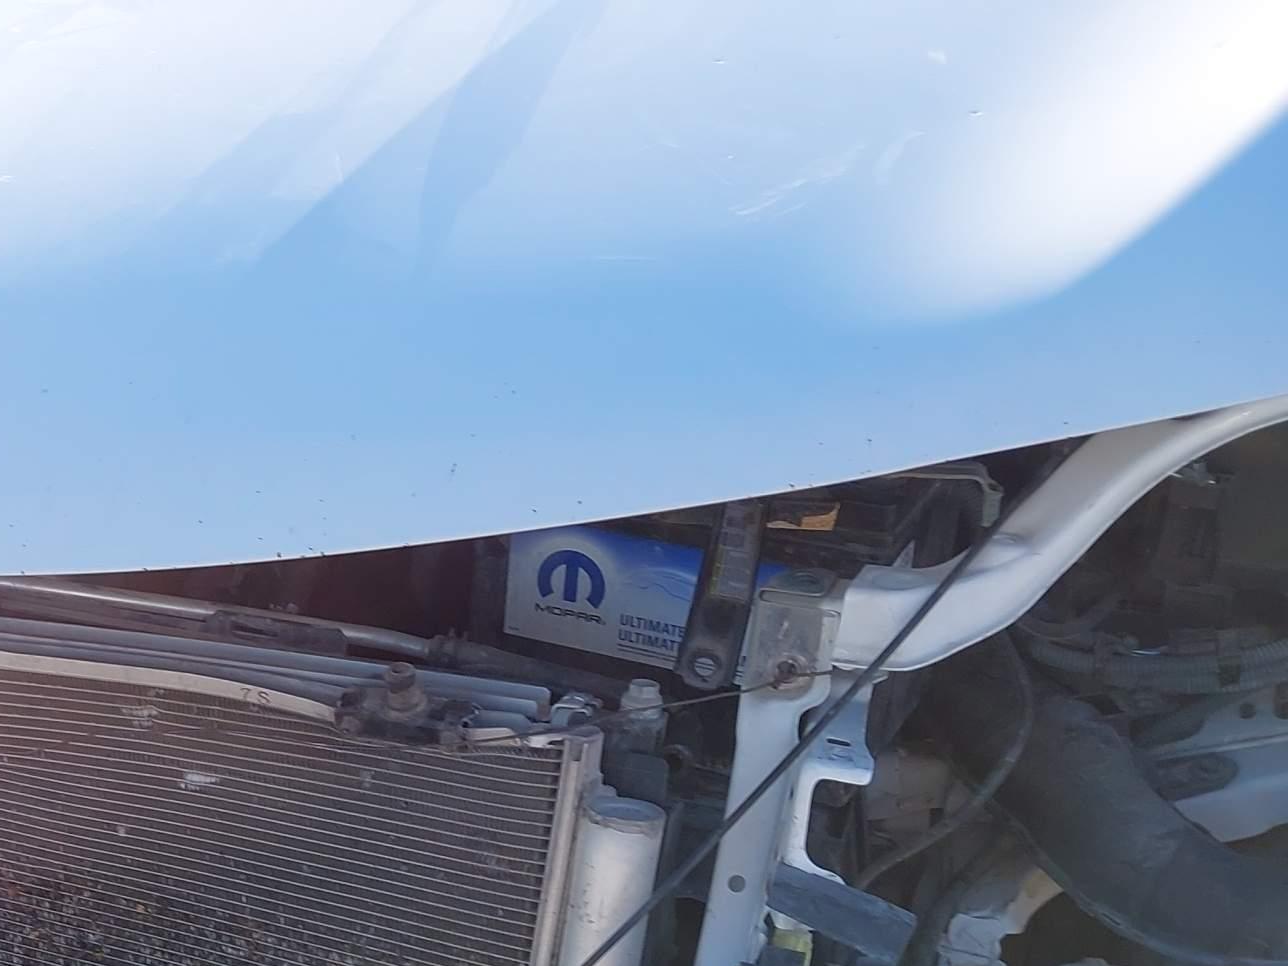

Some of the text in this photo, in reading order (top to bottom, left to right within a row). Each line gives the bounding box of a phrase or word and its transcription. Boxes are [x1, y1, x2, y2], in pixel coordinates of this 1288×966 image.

[535, 603, 604, 625] MOPAR
[619, 613, 686, 639] ULTIMATE
[617, 629, 681, 651] ULTIMAT
